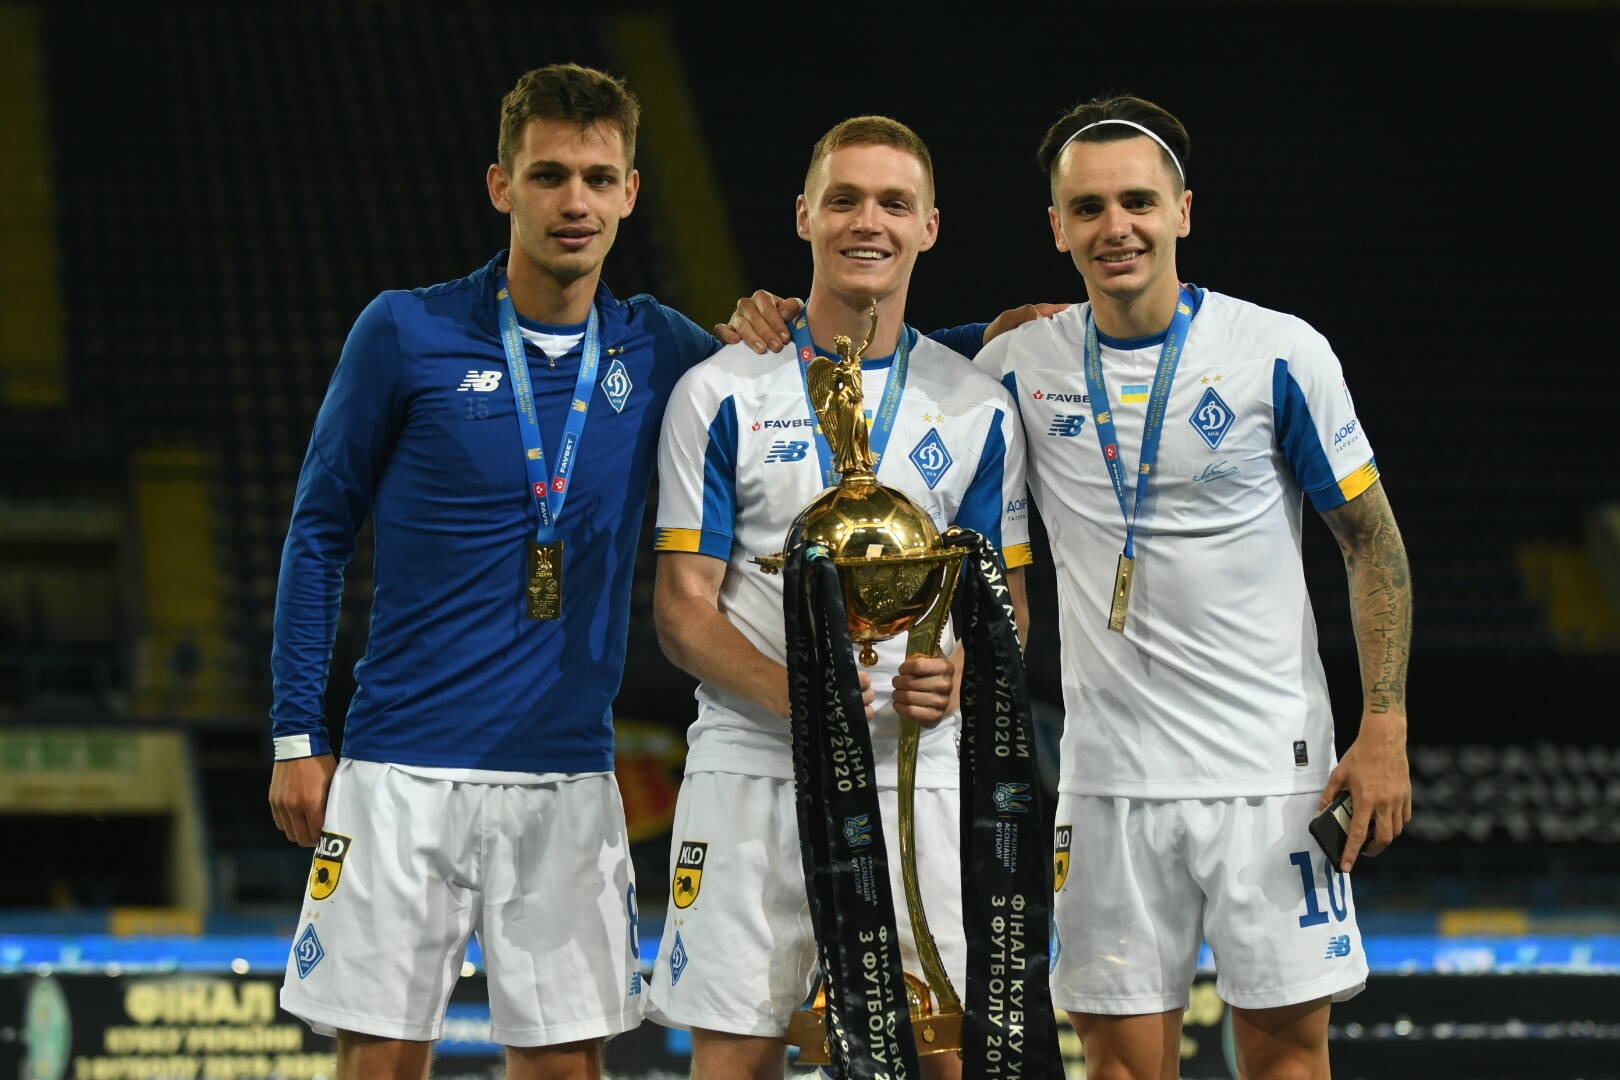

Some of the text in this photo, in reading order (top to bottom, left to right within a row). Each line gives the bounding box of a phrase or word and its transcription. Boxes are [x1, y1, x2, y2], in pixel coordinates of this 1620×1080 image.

[764, 418, 813, 429] FAVBE
[1046, 392, 1092, 403] FAVBE
[559, 438, 574, 474] FAVBET
[679, 846, 704, 865] KLO
[1289, 850, 1348, 929] 10
[877, 925, 896, 1002] ФІНАЛ
[1009, 893, 1026, 971] ФІНАЛ
[862, 951, 889, 1064] ФУТБОЛУ
[988, 915, 1006, 1028] ФУТБОЛУ
[1009, 980, 1026, 1055] КУБКУ
